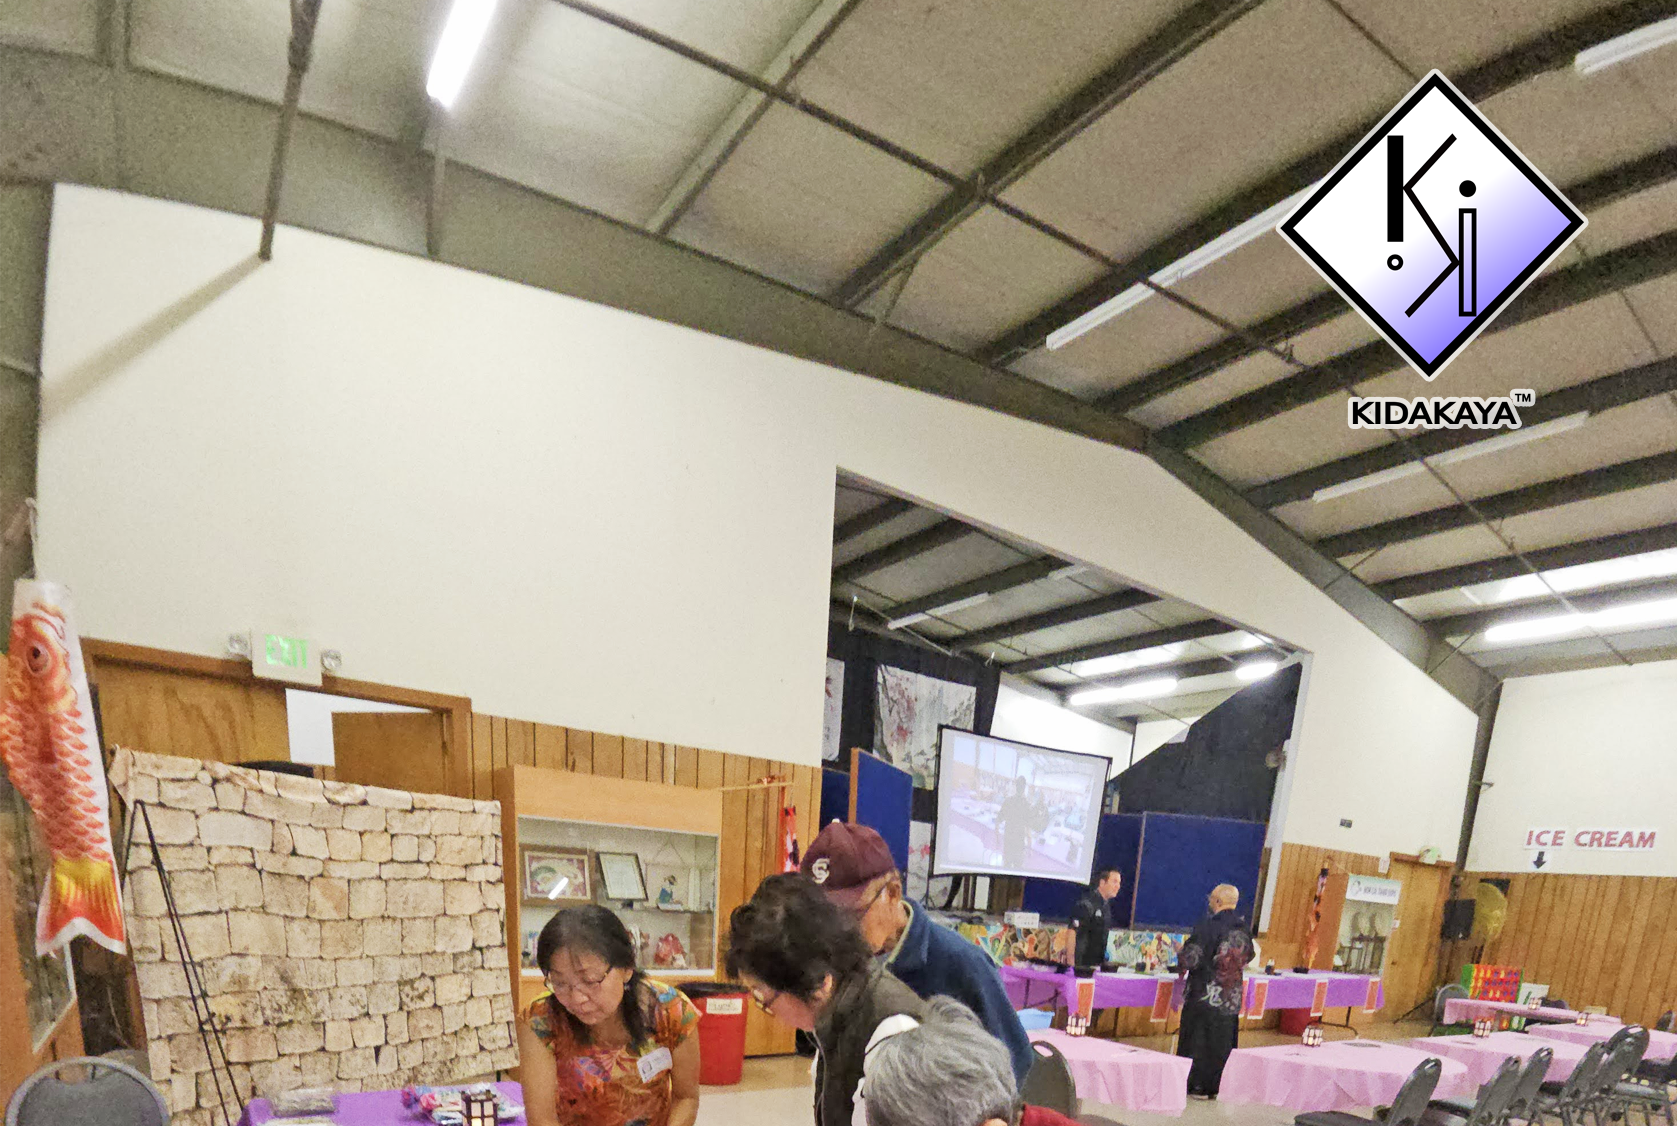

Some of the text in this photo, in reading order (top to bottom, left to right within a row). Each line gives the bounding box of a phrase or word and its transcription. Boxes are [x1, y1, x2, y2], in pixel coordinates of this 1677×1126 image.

[264, 633, 308, 669] EXIT
[1526, 829, 1657, 849] ICE CREAM
